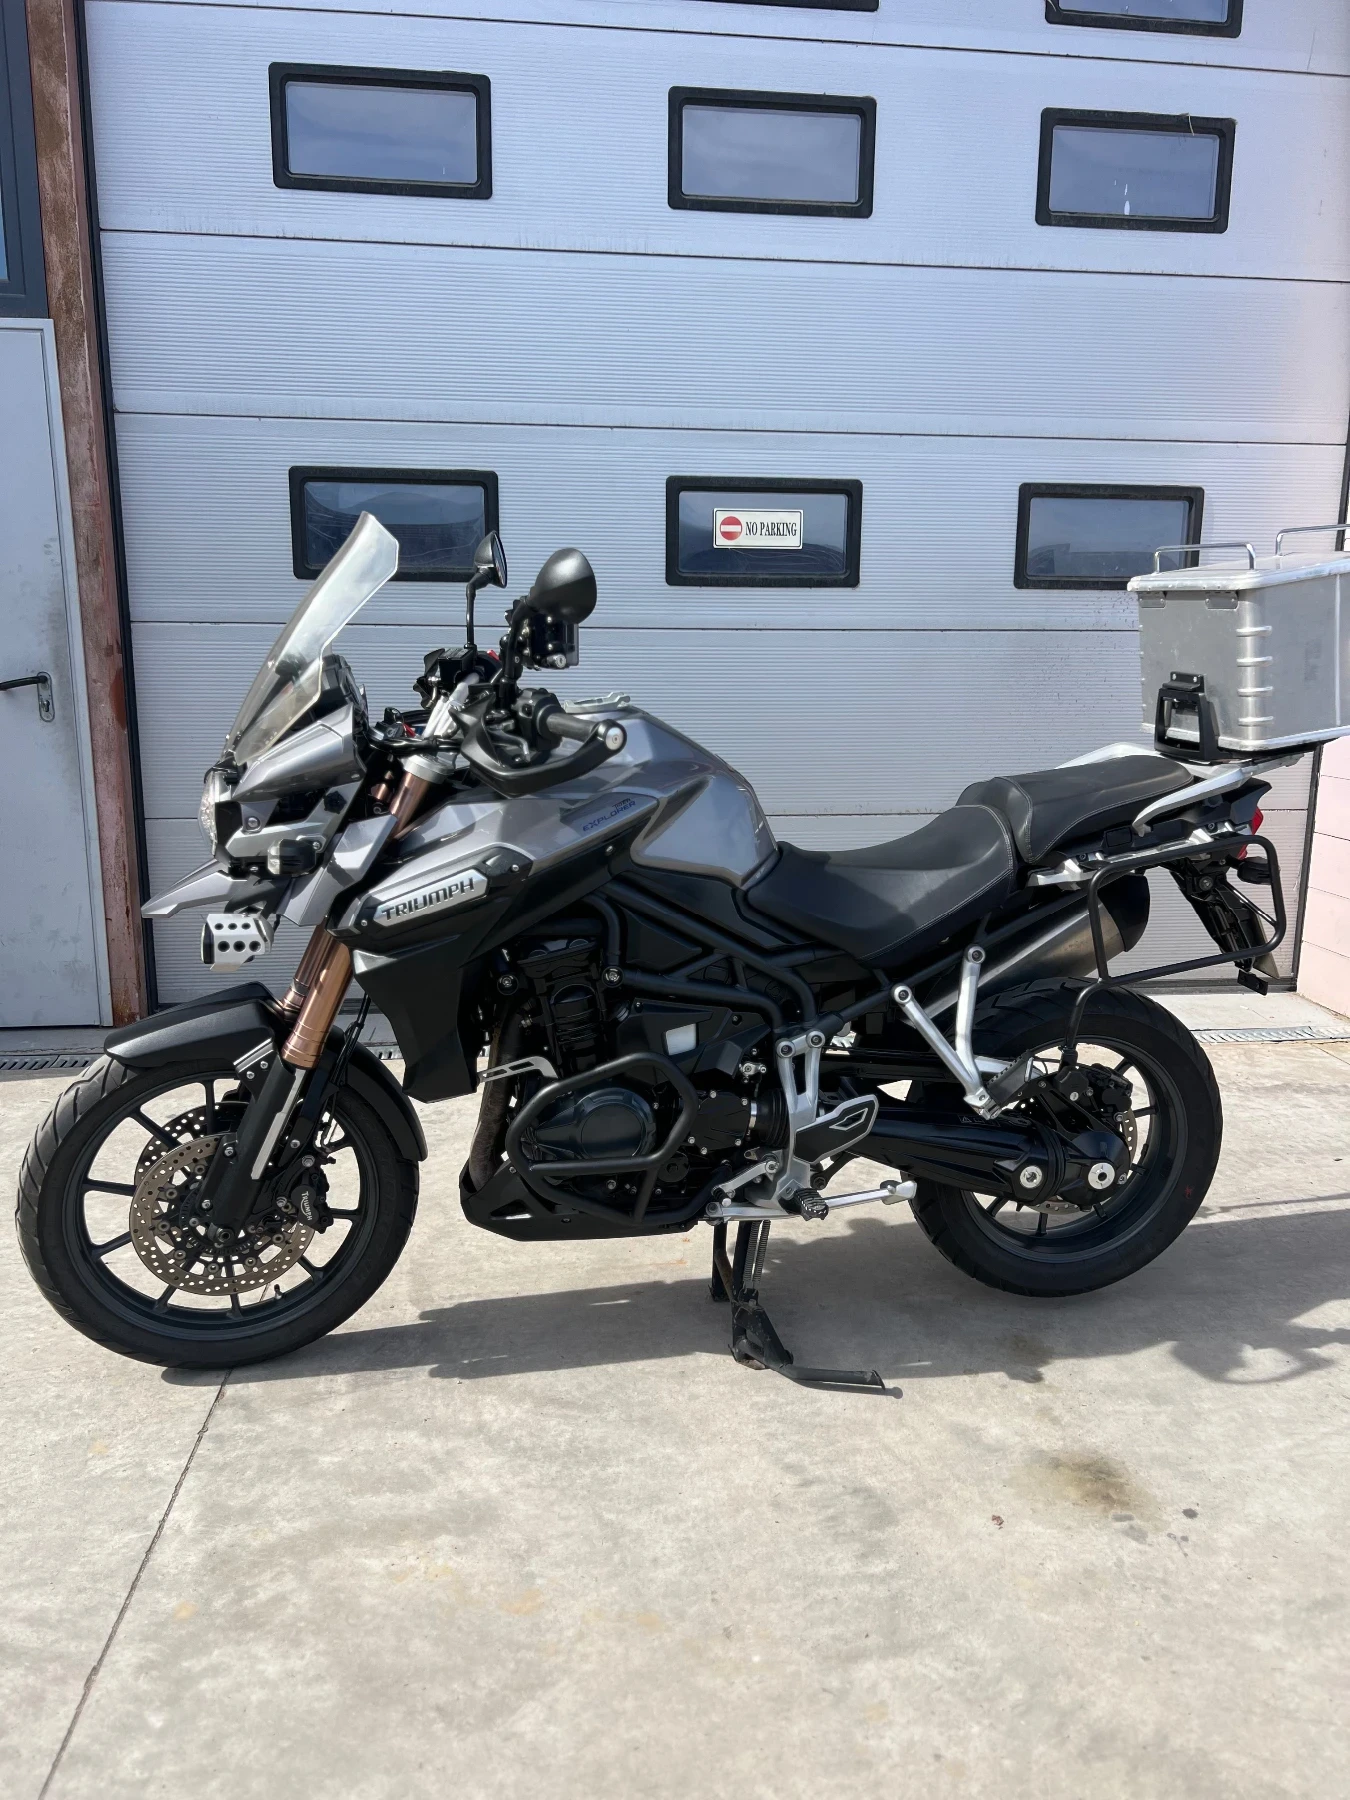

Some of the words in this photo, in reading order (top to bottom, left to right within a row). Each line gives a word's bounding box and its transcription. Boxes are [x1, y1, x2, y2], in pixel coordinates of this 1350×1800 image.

[745, 521, 757, 536] NO
[759, 521, 797, 537] PARKING
[582, 800, 636, 832] EXPLORER
[381, 877, 475, 921] TRIUMPH
[301, 1191, 313, 1221] TRIUMPH
